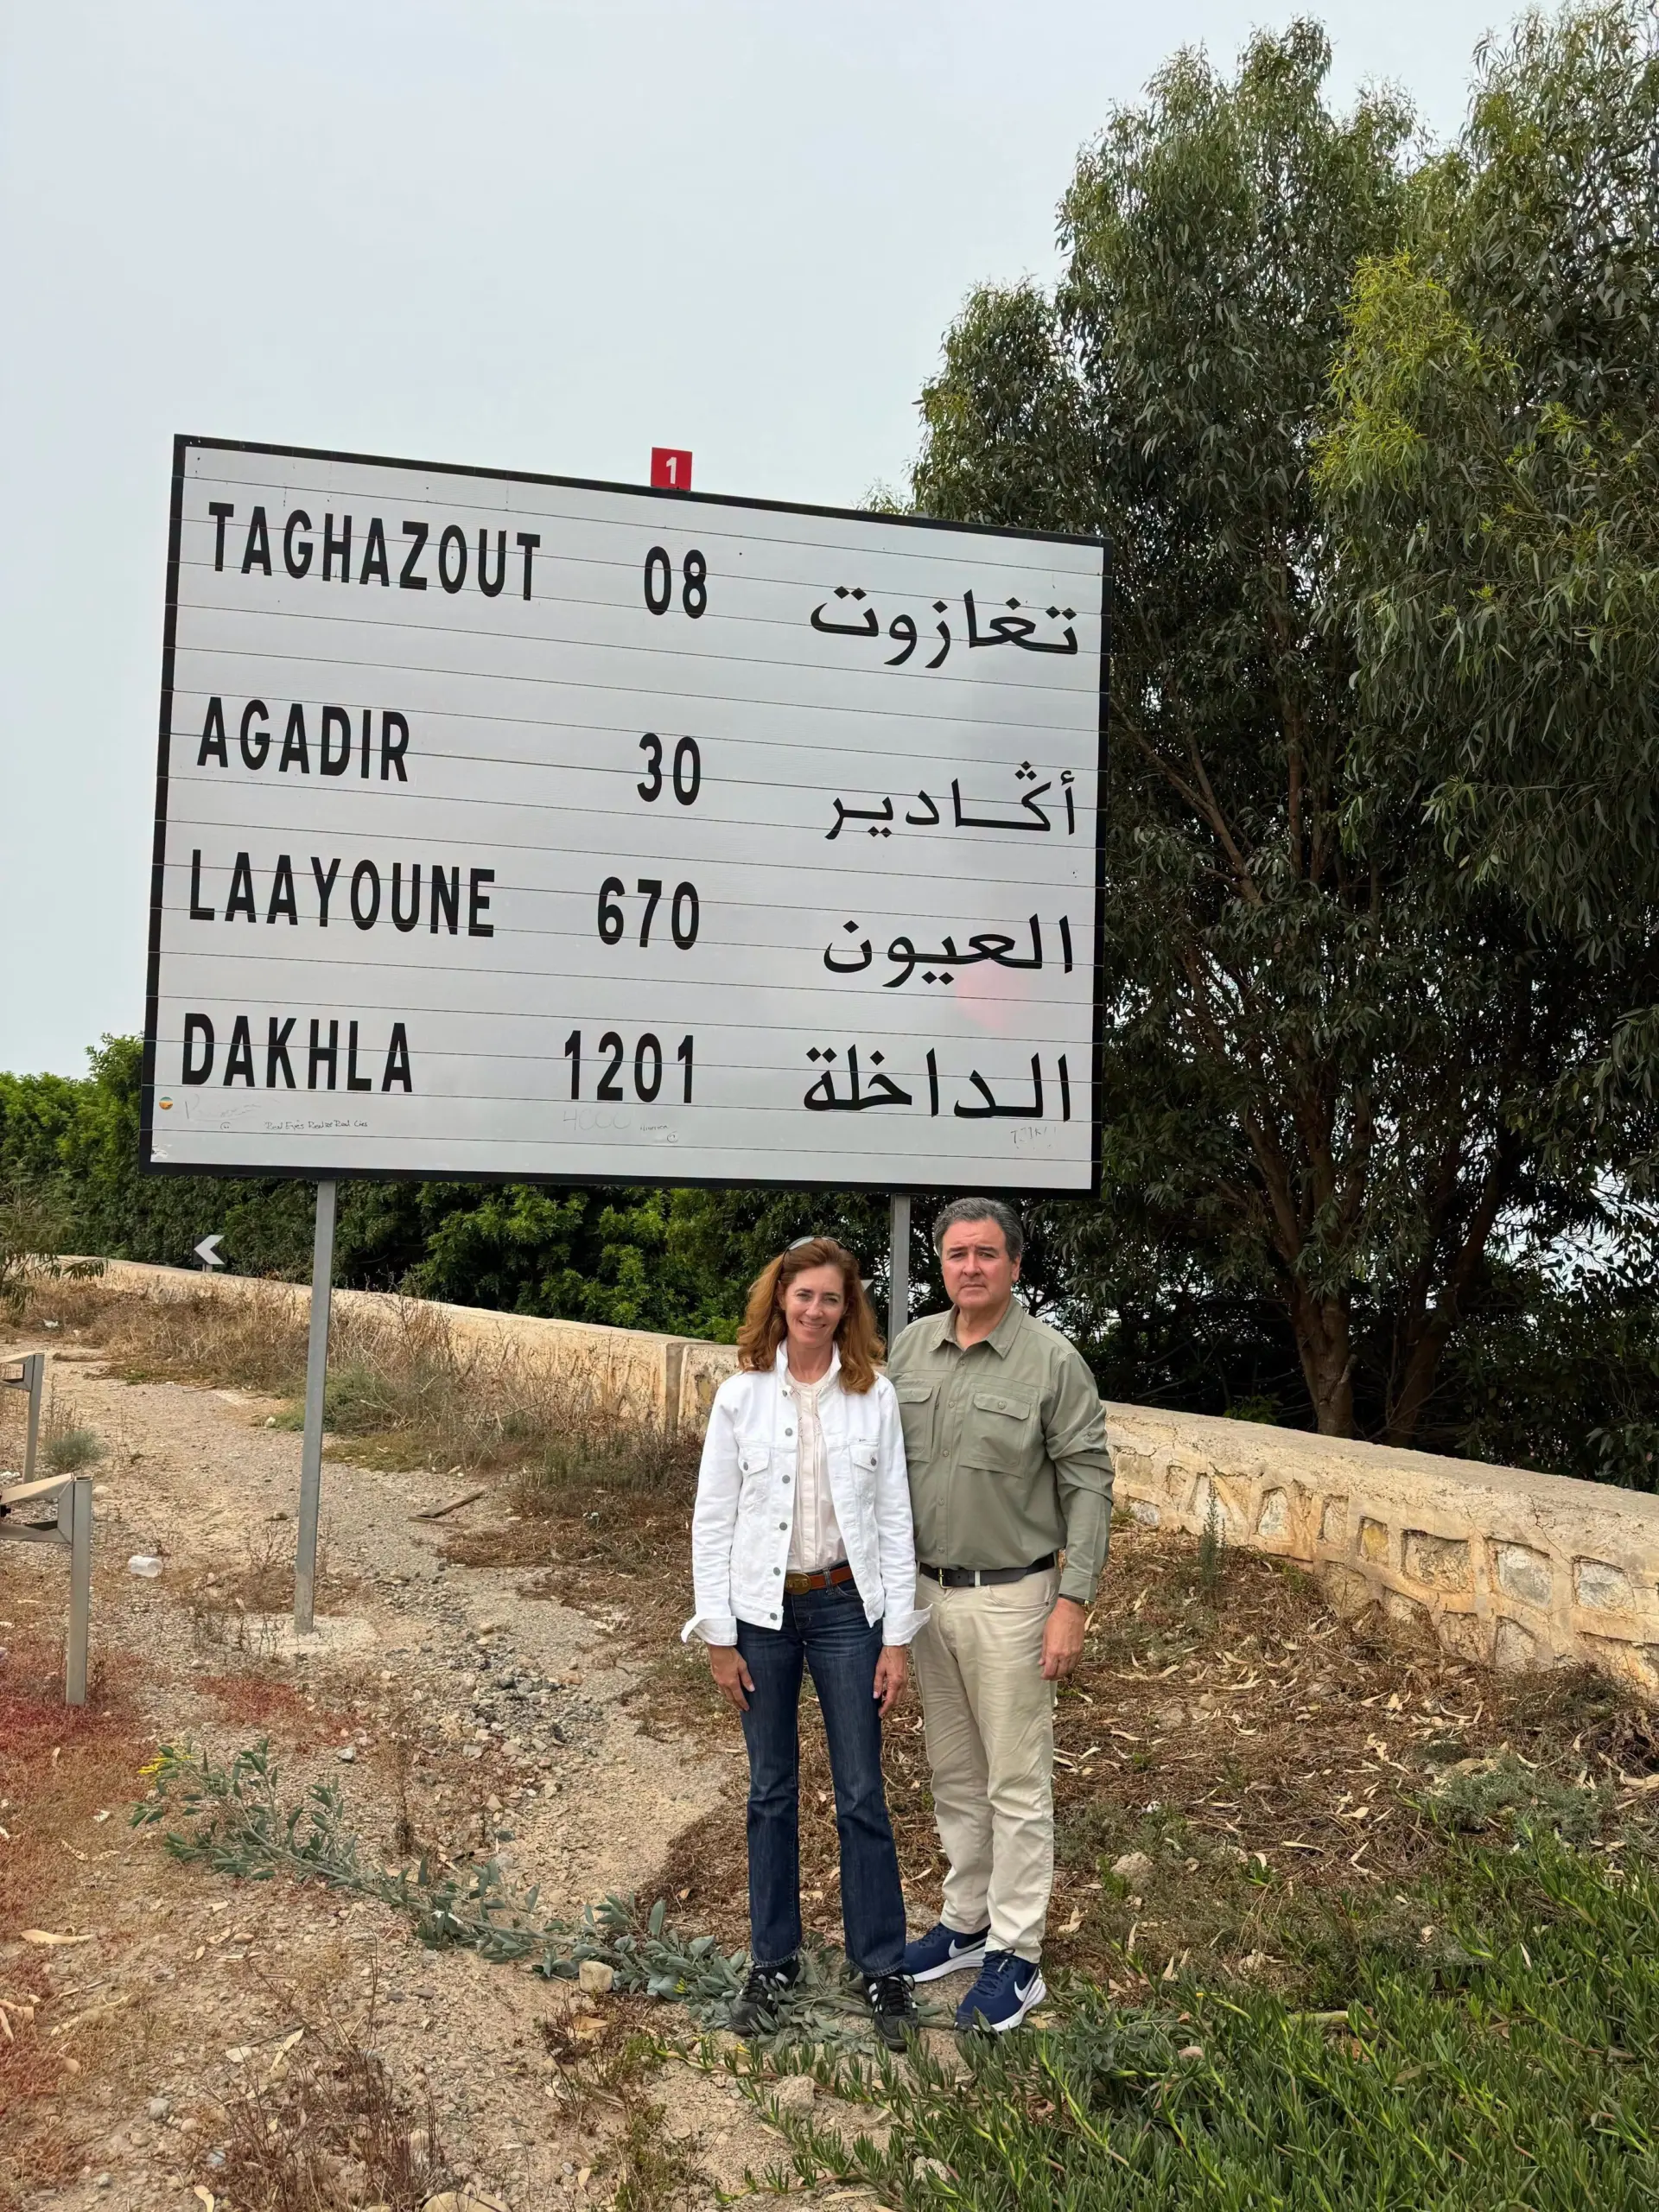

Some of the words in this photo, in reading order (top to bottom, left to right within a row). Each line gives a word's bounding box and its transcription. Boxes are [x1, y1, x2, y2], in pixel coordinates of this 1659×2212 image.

[665, 456, 677, 485] 1
[208, 501, 542, 602] TAGHAZOUT
[644, 546, 709, 620] 08
[810, 585, 1079, 670] تغازوت
[197, 696, 411, 784] AGADIR
[637, 733, 702, 808] 30
[189, 849, 497, 939] LAAYOUNE
[597, 876, 701, 952] 670
[823, 913, 1074, 989] العيون
[181, 1013, 414, 1095] DAKHLA
[564, 1030, 696, 1105] 1201
[803, 1043, 1072, 1123] الداخلة
